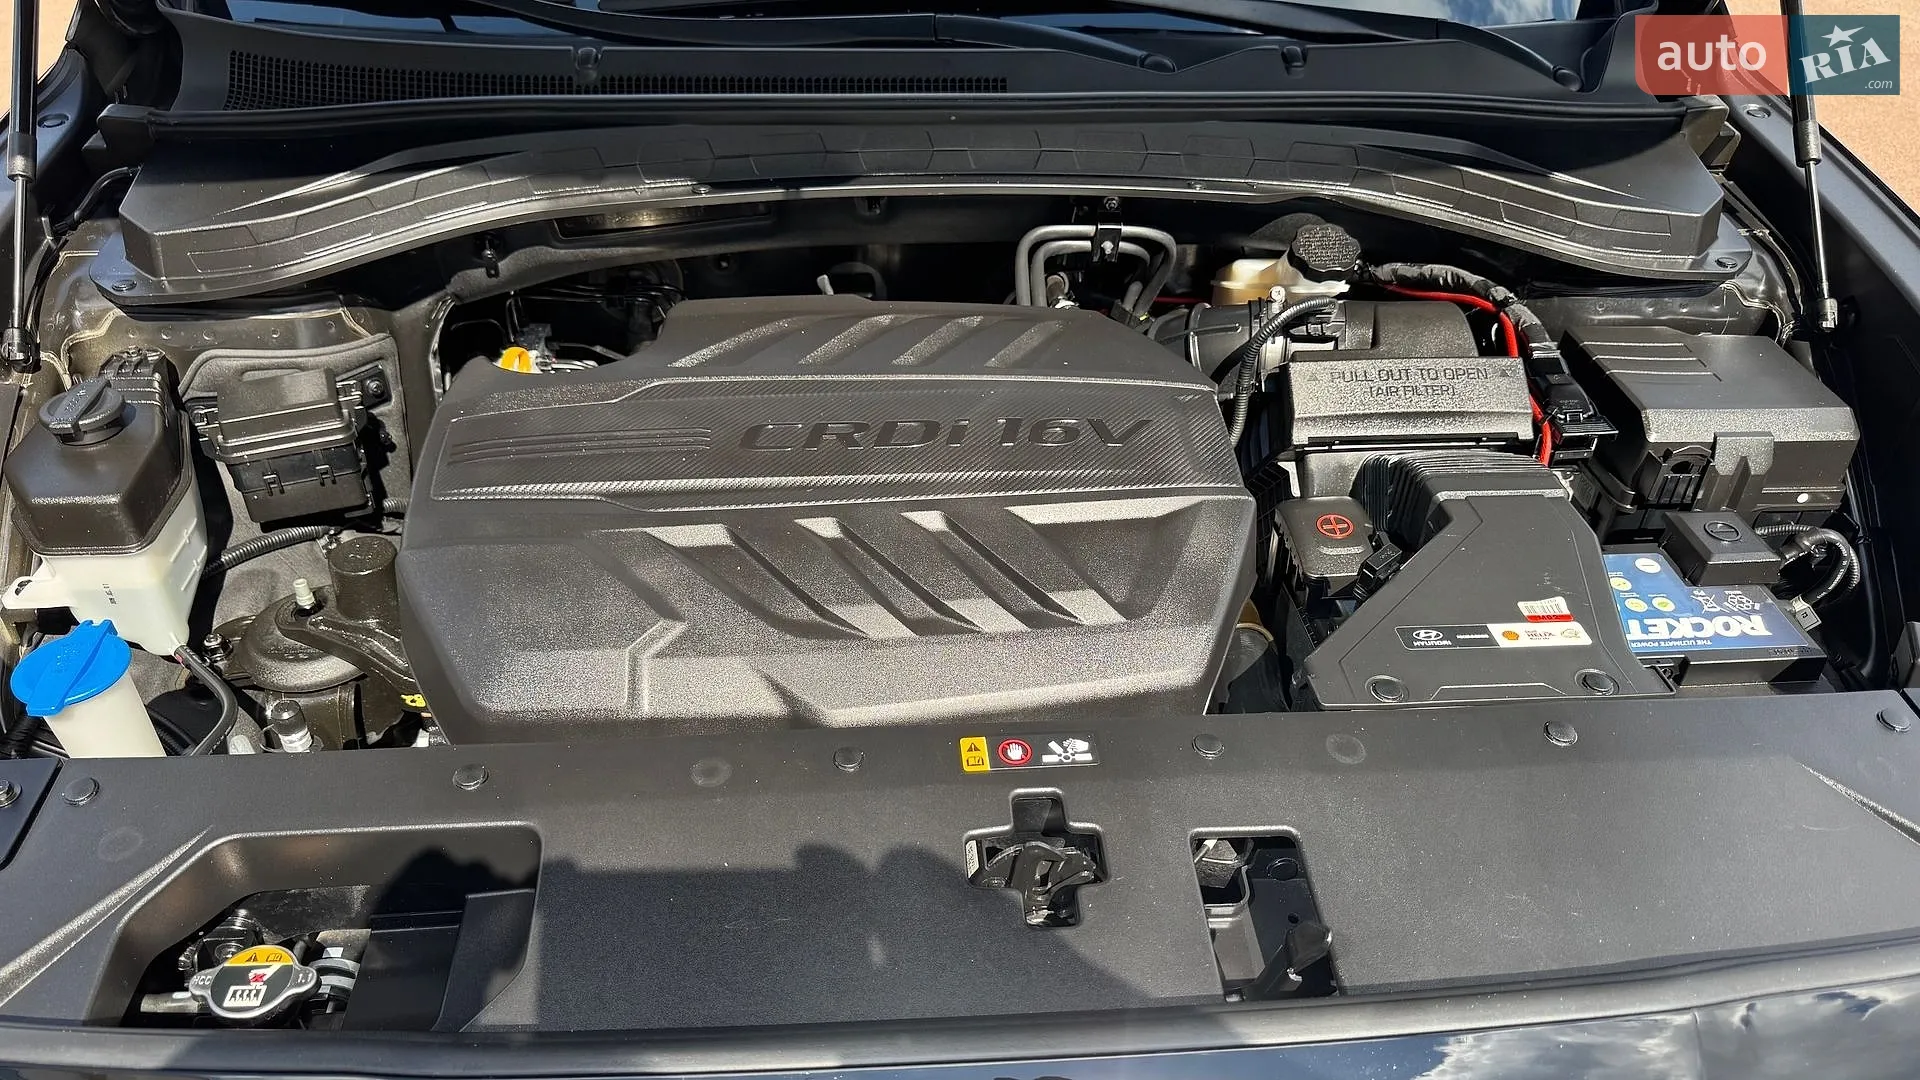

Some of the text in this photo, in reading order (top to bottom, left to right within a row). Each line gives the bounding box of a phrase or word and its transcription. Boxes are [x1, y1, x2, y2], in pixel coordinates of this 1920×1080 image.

[1330, 367, 1489, 383] PULL OUT TO OPEN
[738, 415, 1154, 452] CRDi 16V
[1625, 614, 1773, 640] ROCKET
[1412, 639, 1453, 647] HYUNDAI
[1630, 640, 1659, 648] POWER
[1659, 639, 1695, 648] ULTIMATE
[191, 975, 213, 986] HCC
[296, 973, 313, 984] 1.1
